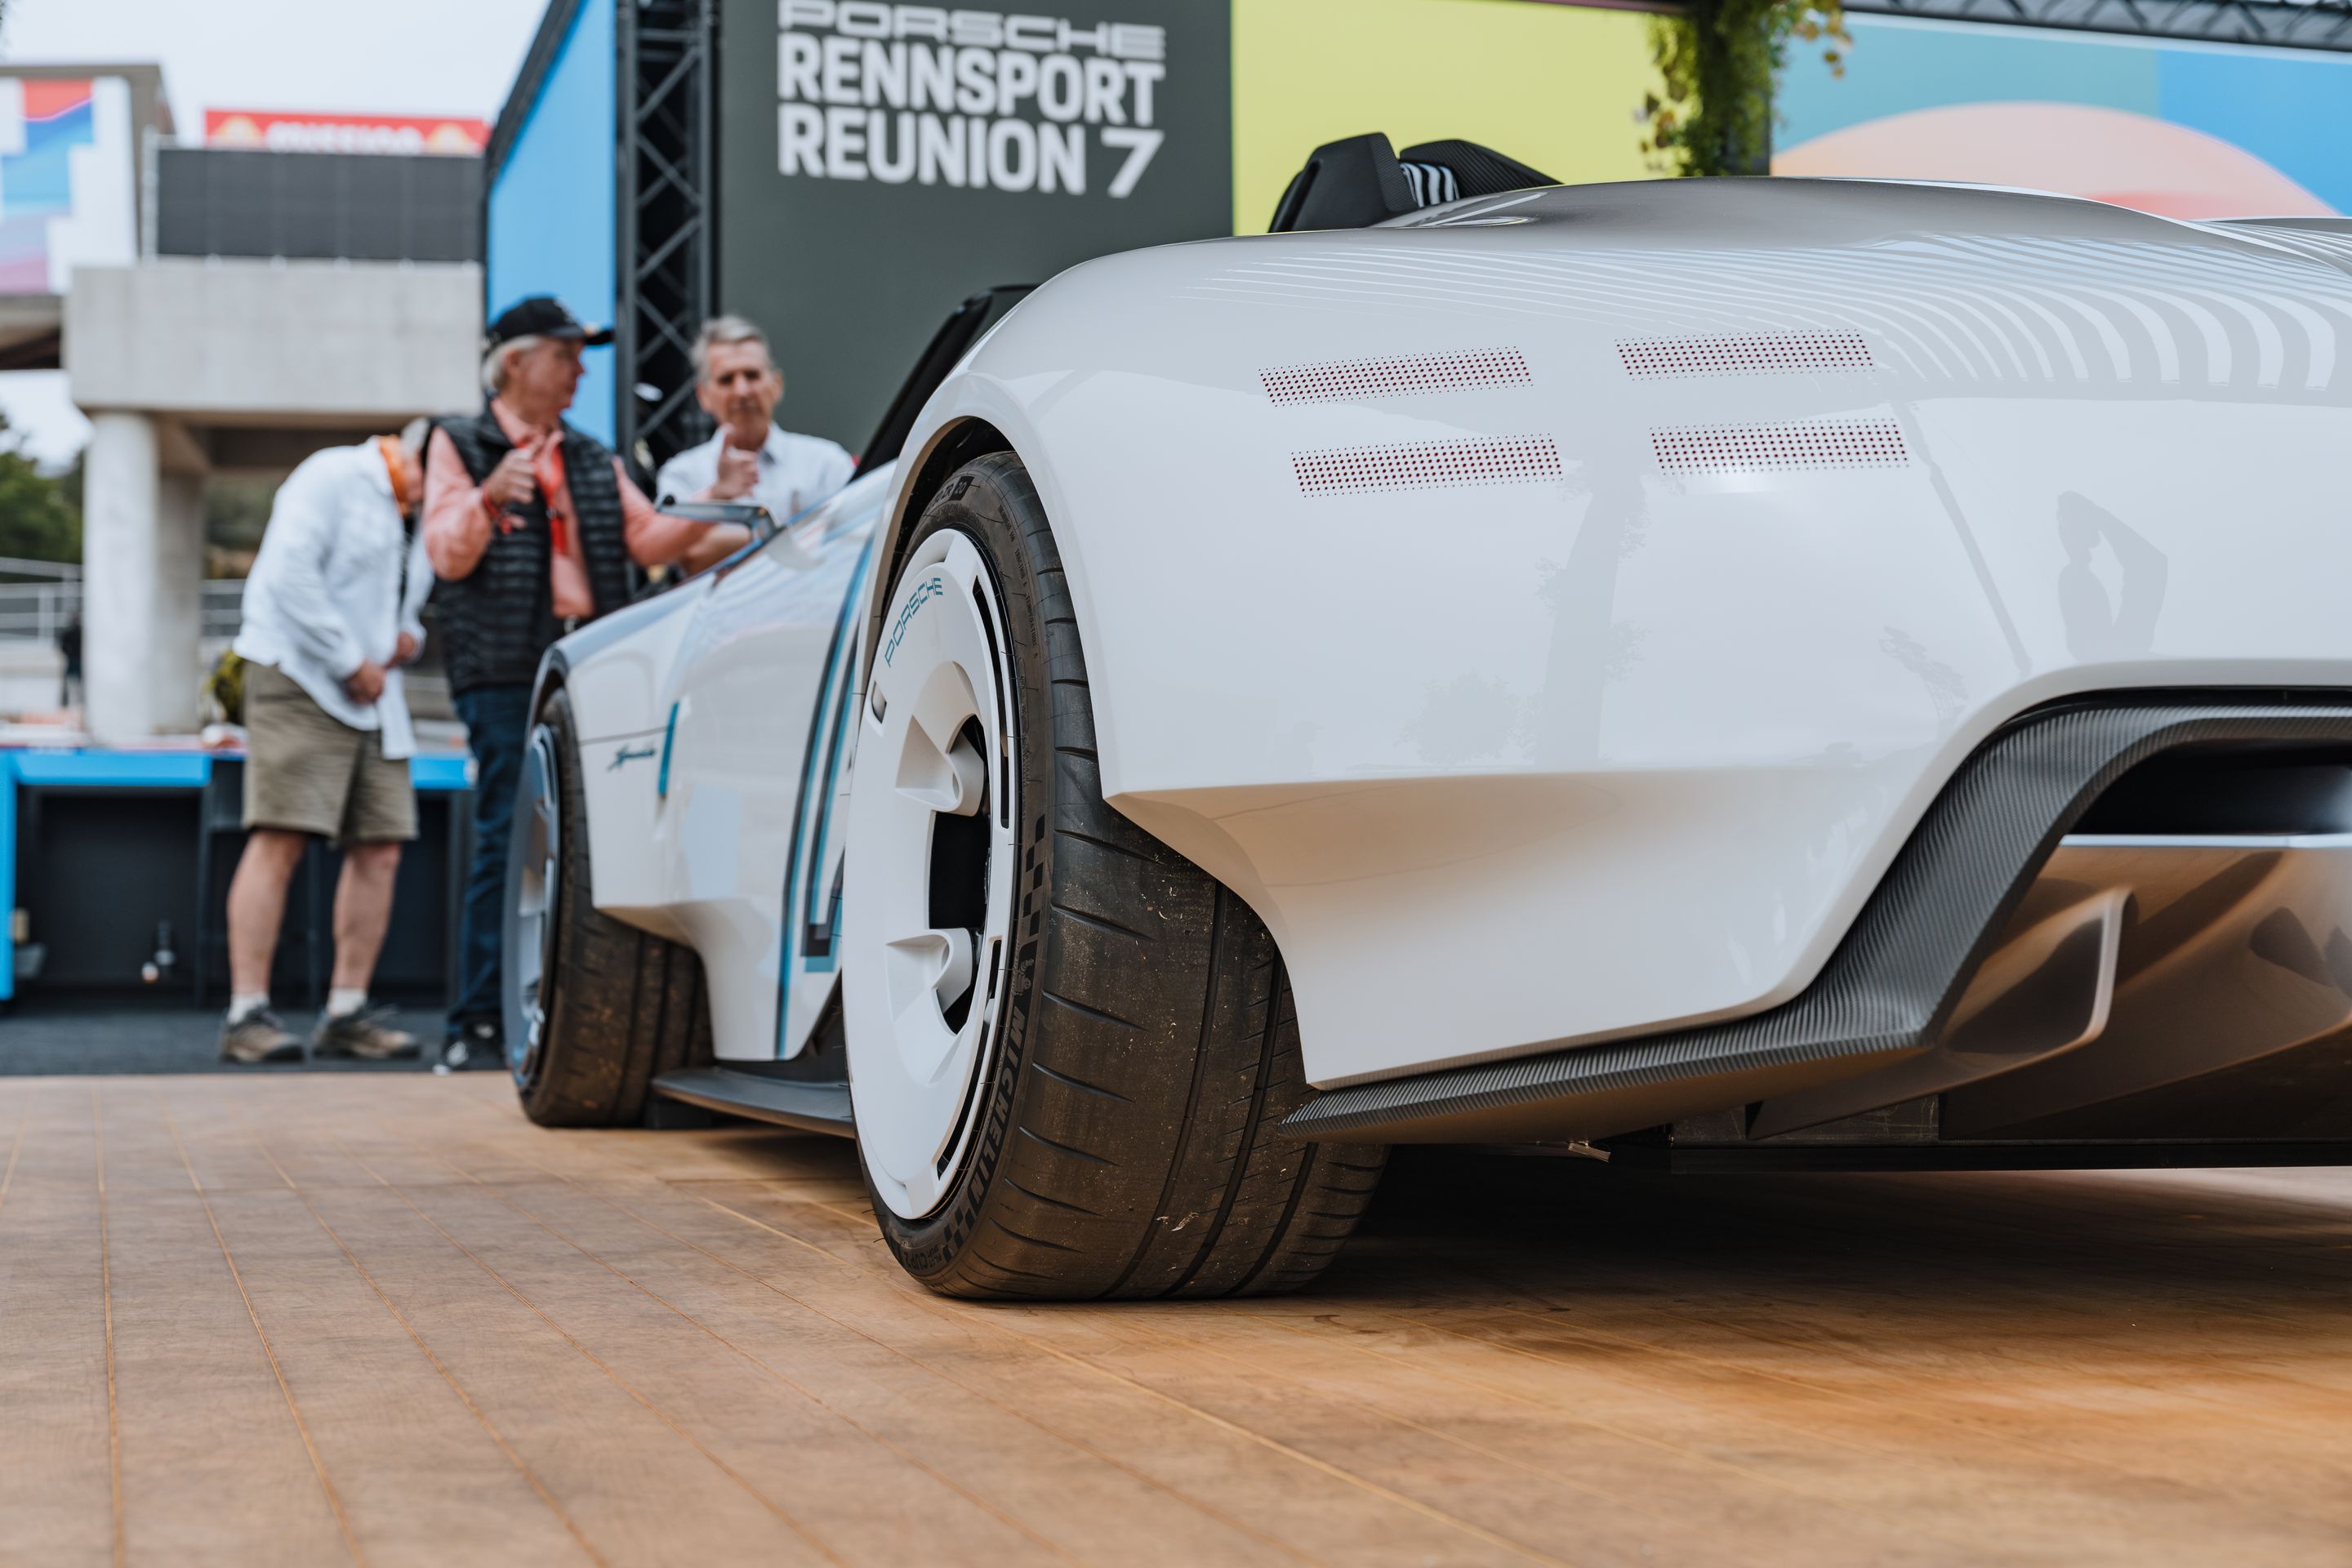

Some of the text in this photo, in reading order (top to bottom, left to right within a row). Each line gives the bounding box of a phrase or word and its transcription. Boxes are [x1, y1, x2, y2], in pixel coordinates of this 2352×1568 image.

[777, 0, 1166, 61] PORSCHE
[777, 32, 1166, 127] RENNSPORT
[777, 102, 1166, 198] REUNION 7
[884, 577, 943, 668] PORSCHE
[969, 1005, 1026, 1203] MICHELIN
